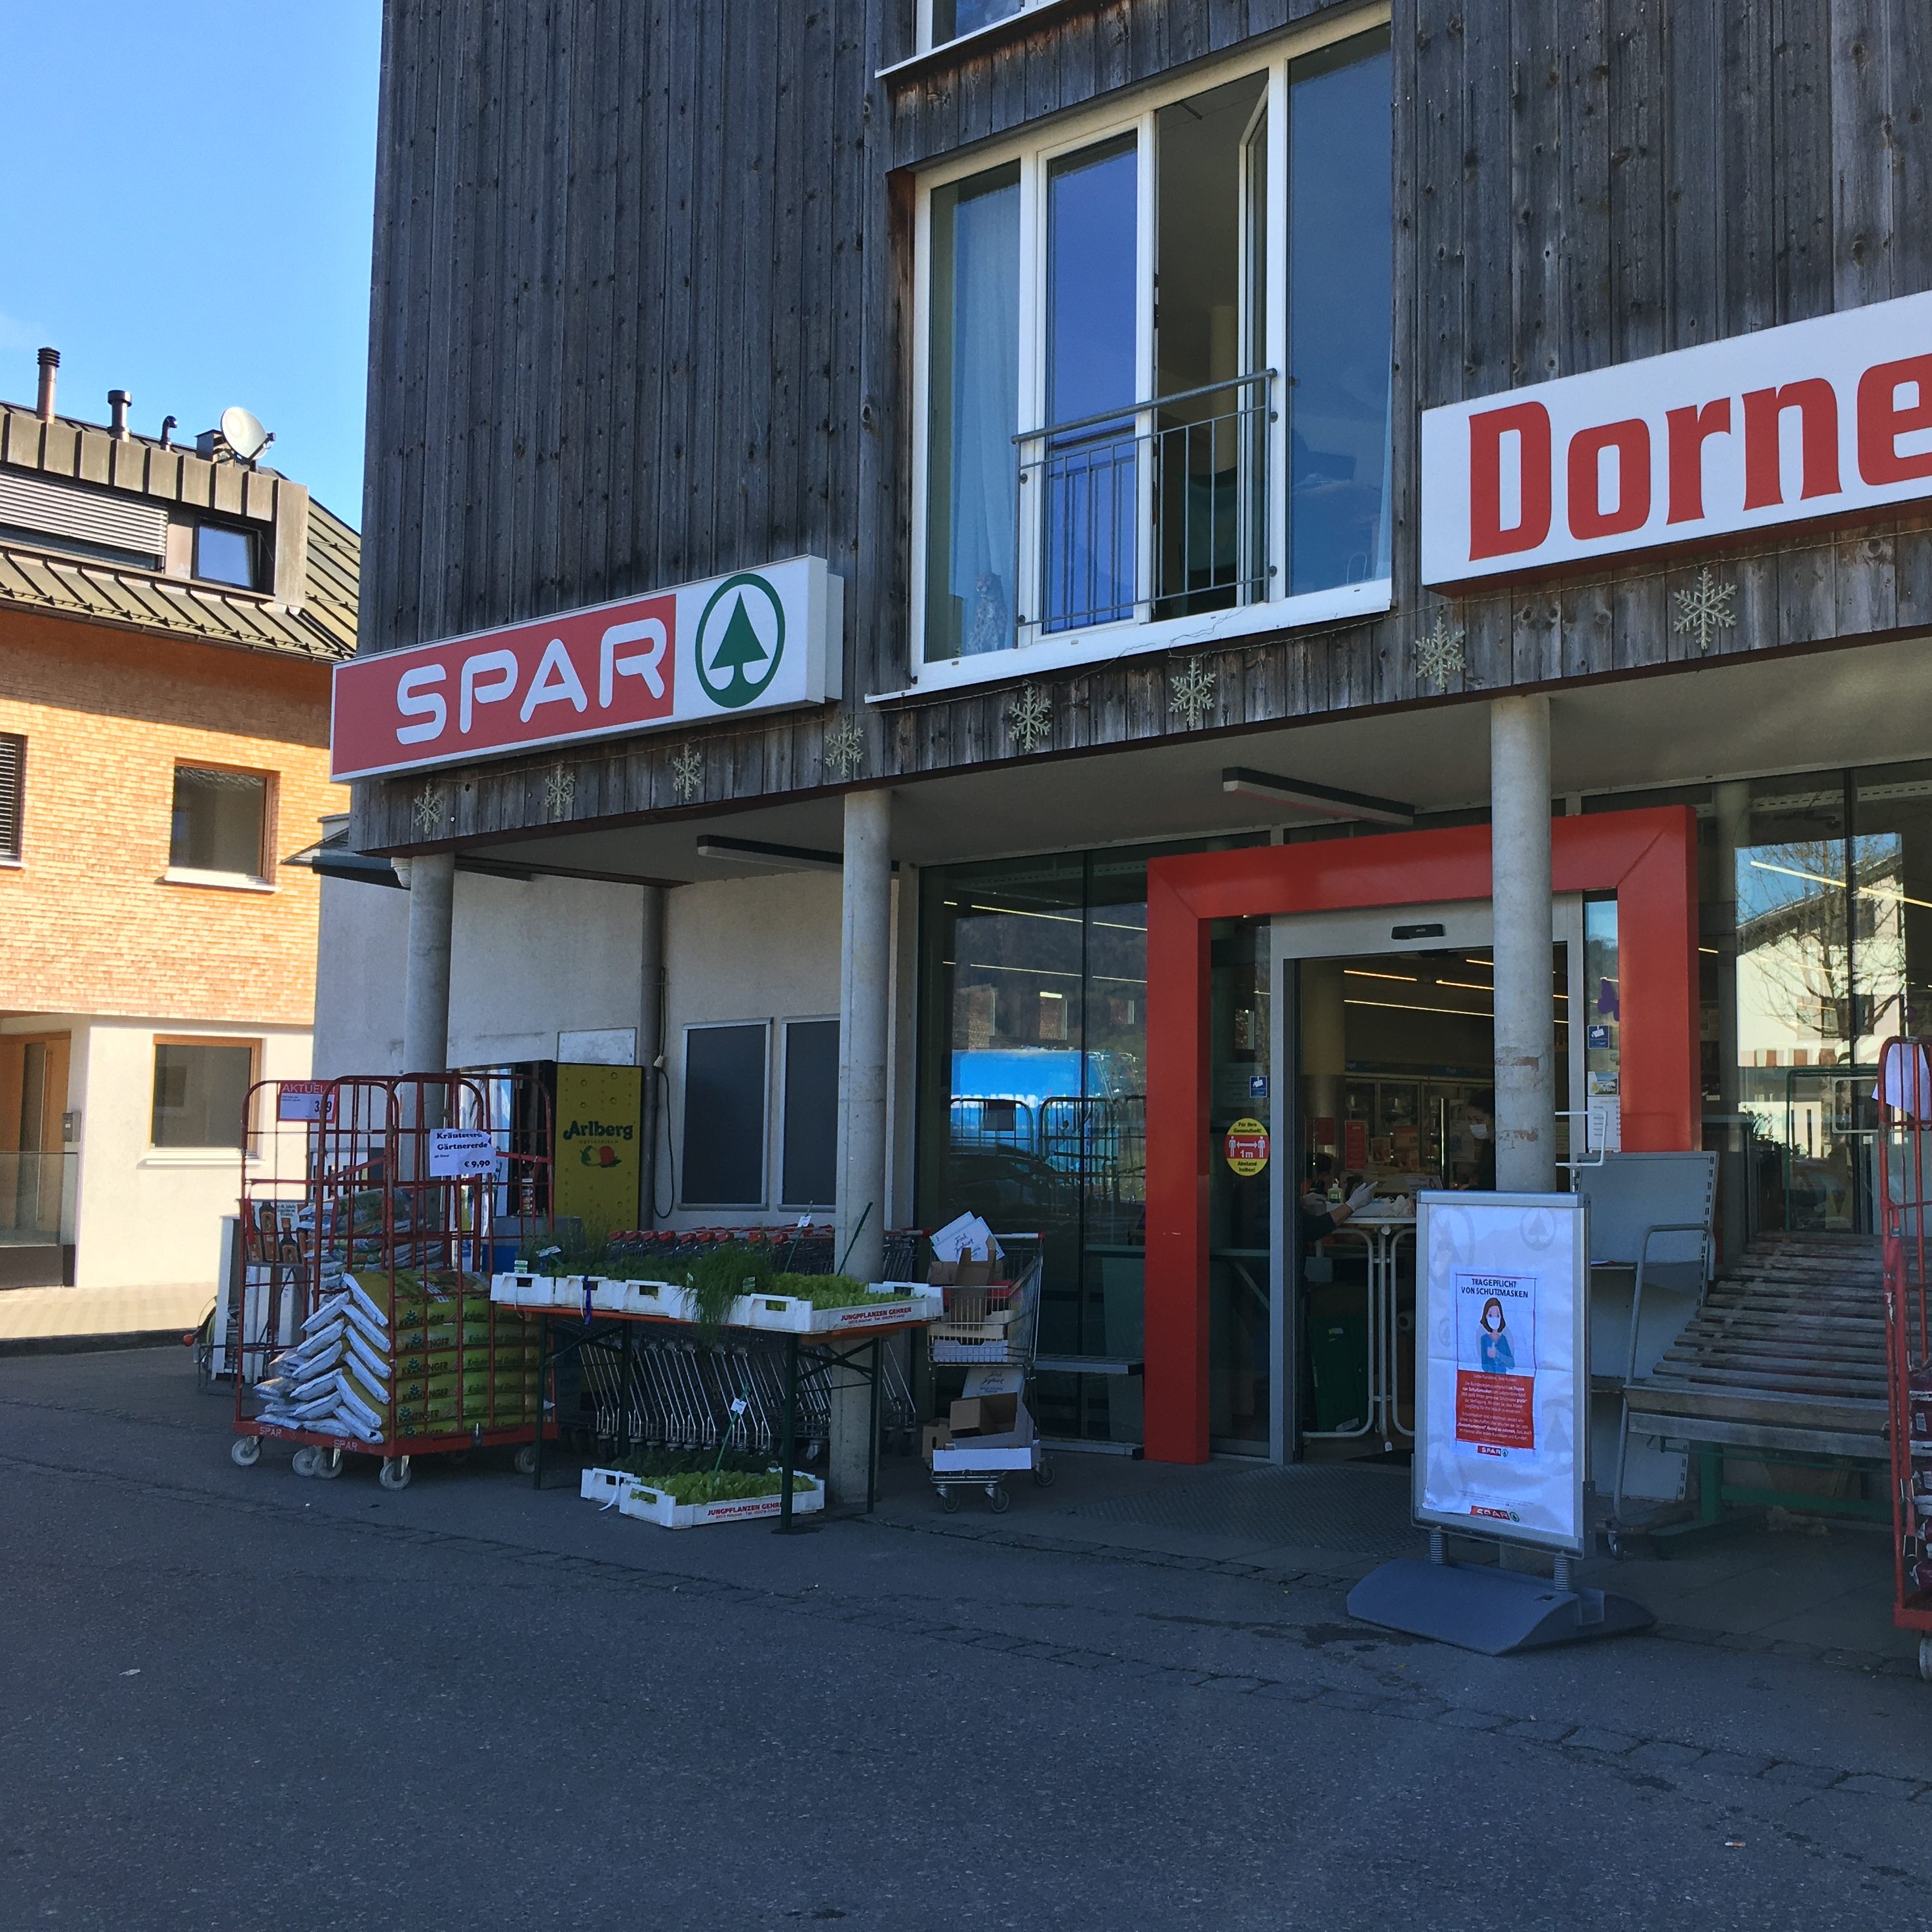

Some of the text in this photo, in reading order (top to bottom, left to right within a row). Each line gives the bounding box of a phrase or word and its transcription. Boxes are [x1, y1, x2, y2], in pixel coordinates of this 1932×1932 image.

[396, 618, 668, 745] SPAR
[563, 1120, 634, 1140] Arlberg
[437, 1142, 488, 1151] Gärtnererde
[1240, 1149, 1253, 1158] 1m
[1471, 1278, 1517, 1288] TRAGEPFLICHT
[1476, 1288, 1529, 1298] SCHUTZMASKEN
[841, 1310, 888, 1321] JUNGPFLANZEN
[260, 1426, 282, 1438] SPAR
[333, 1439, 358, 1452] SPAR
[708, 1504, 760, 1516] JUNGPFLANZEN
